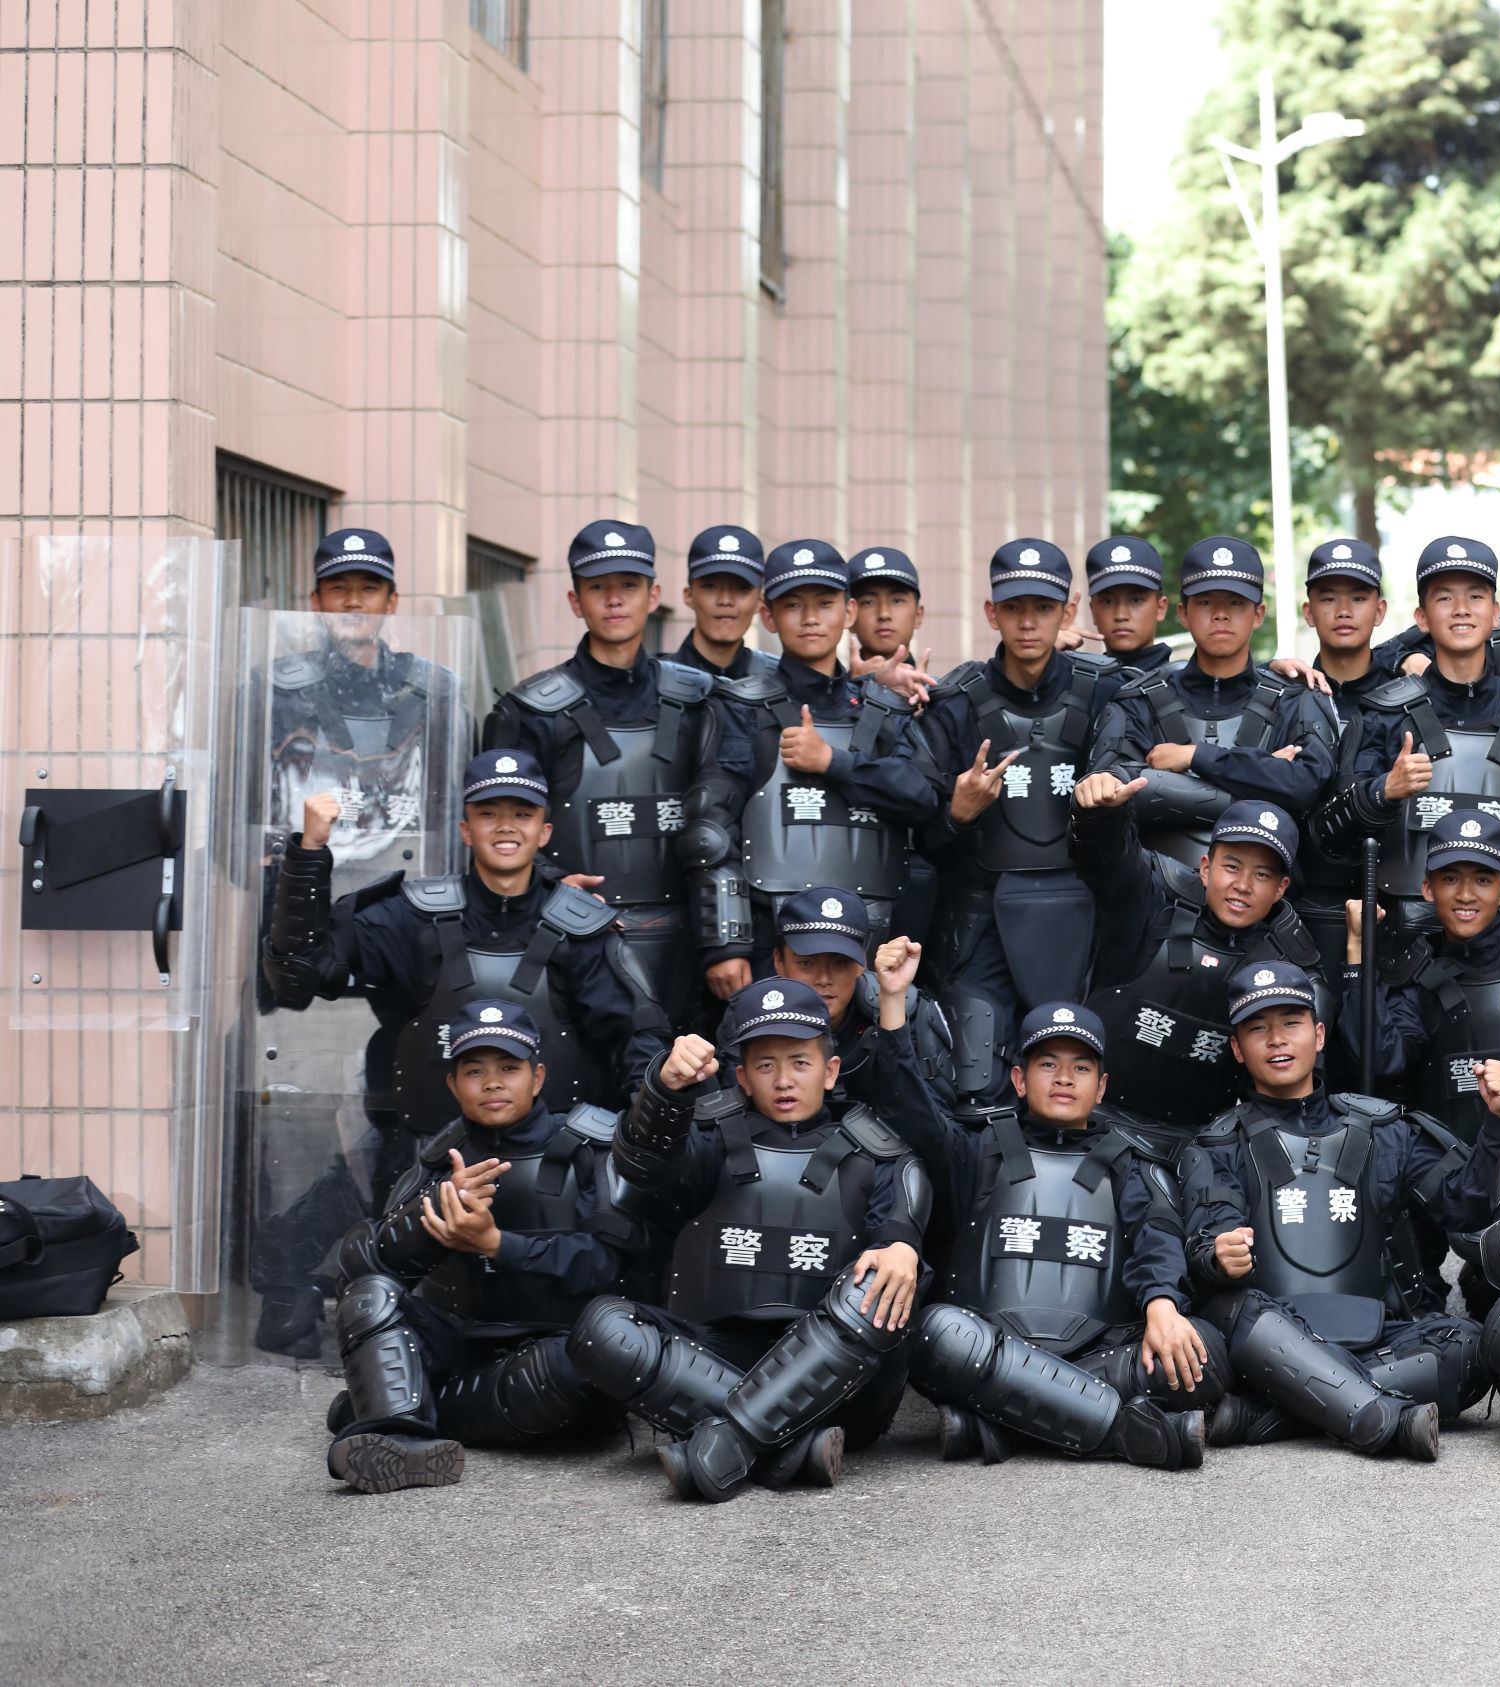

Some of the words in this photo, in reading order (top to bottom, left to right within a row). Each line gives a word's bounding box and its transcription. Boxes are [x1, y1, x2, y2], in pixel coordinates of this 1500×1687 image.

[1002, 763, 1076, 799] 警察
[597, 798, 688, 836] 警察
[1134, 1006, 1230, 1064] 警察
[1276, 1186, 1358, 1225] 警察
[719, 1227, 830, 1272] 警察
[999, 1217, 1107, 1263] 警察
